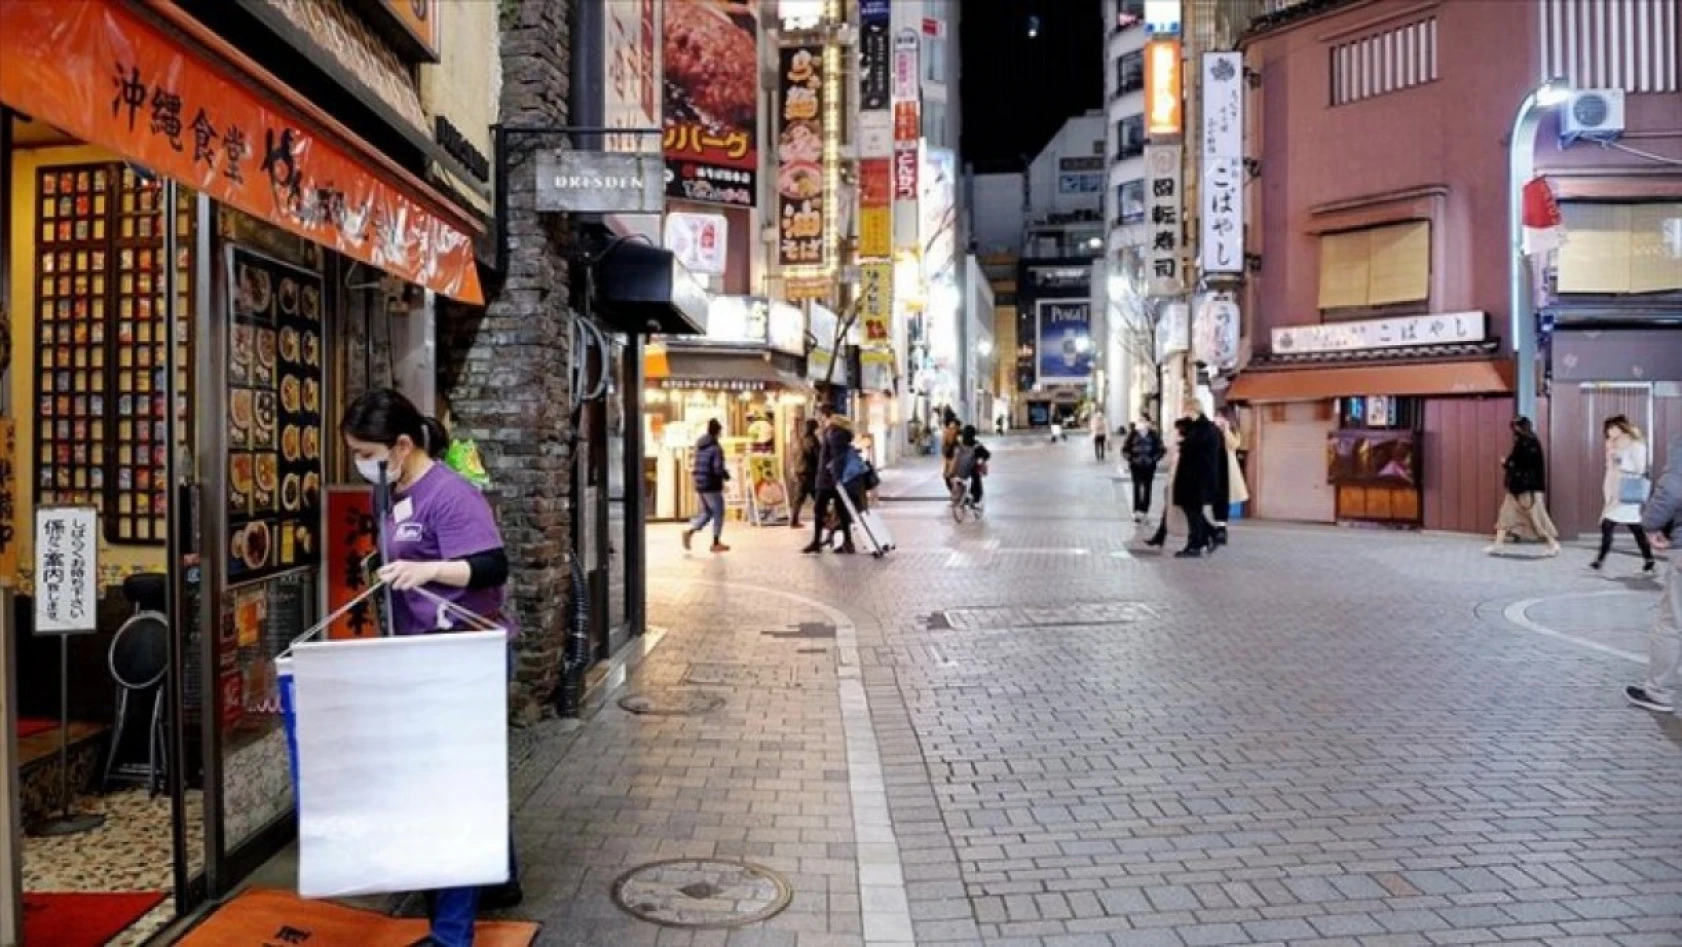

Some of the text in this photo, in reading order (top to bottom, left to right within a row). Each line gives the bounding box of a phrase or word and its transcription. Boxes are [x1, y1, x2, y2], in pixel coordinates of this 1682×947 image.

[112, 63, 246, 185] 沖縄食堂
[1151, 177, 1177, 279] 回転寿司
[1212, 166, 1237, 266] こばやし
